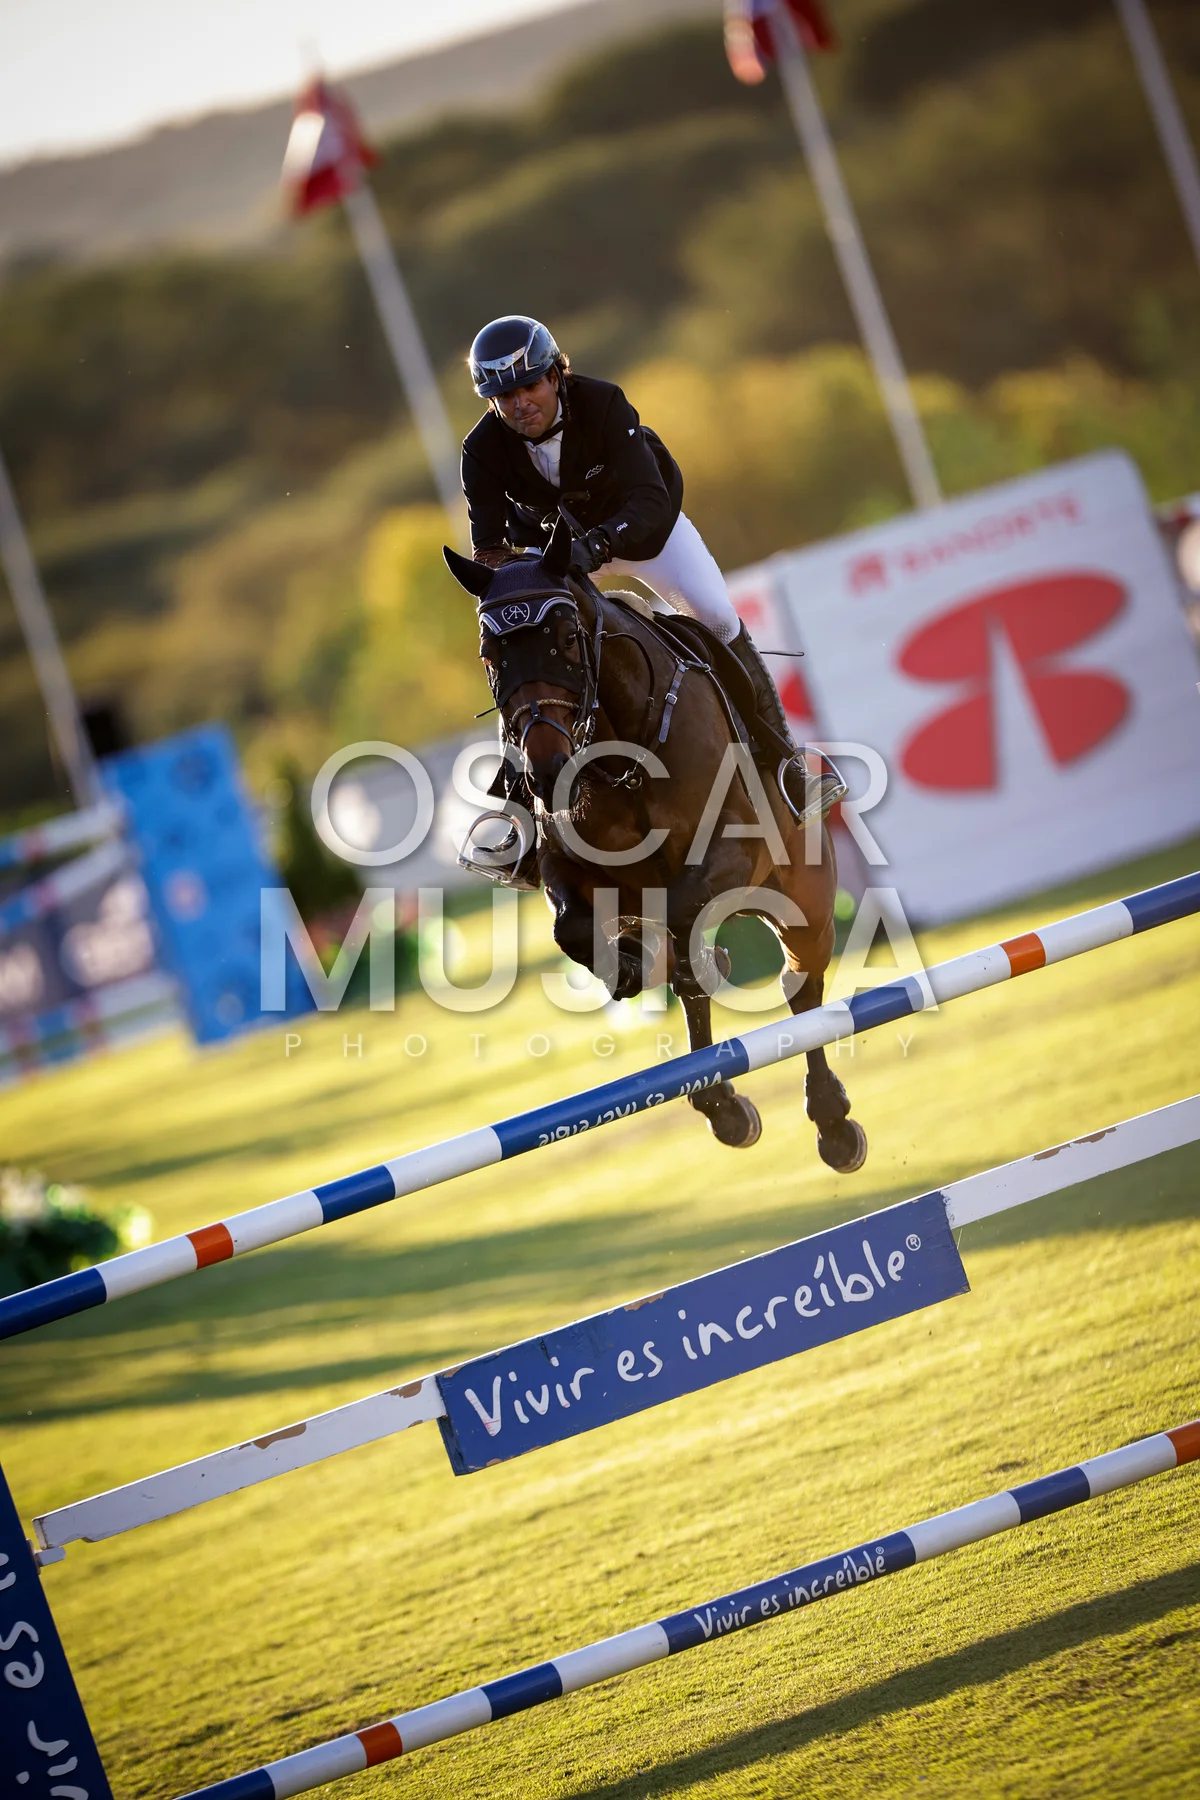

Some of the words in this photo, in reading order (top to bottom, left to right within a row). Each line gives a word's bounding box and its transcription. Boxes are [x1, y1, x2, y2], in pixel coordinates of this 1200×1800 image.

[464, 1356, 595, 1437] Vivir
[617, 1341, 663, 1382] es
[694, 1600, 752, 1639] Vivir
[760, 1594, 781, 1616] es
